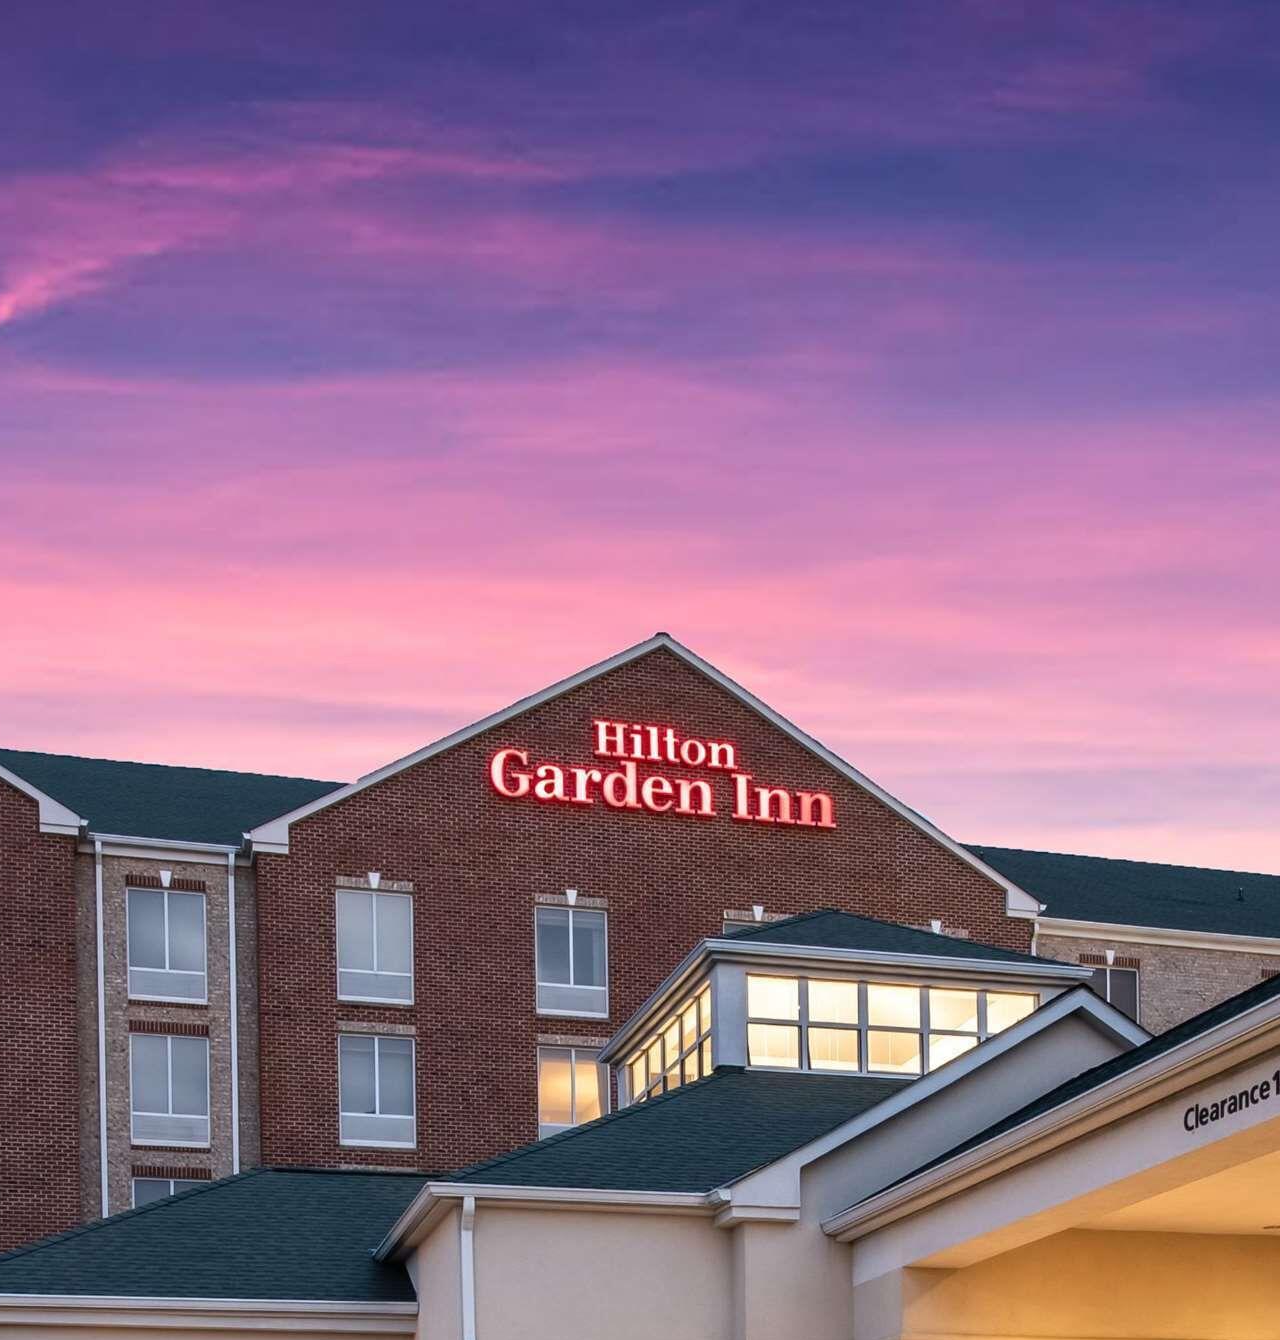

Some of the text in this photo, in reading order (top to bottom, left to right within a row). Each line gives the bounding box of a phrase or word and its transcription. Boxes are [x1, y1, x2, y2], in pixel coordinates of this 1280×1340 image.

[593, 719, 738, 769] Hilton
[489, 748, 837, 828] Garden Inn
[1183, 1080, 1271, 1132] Clearance
